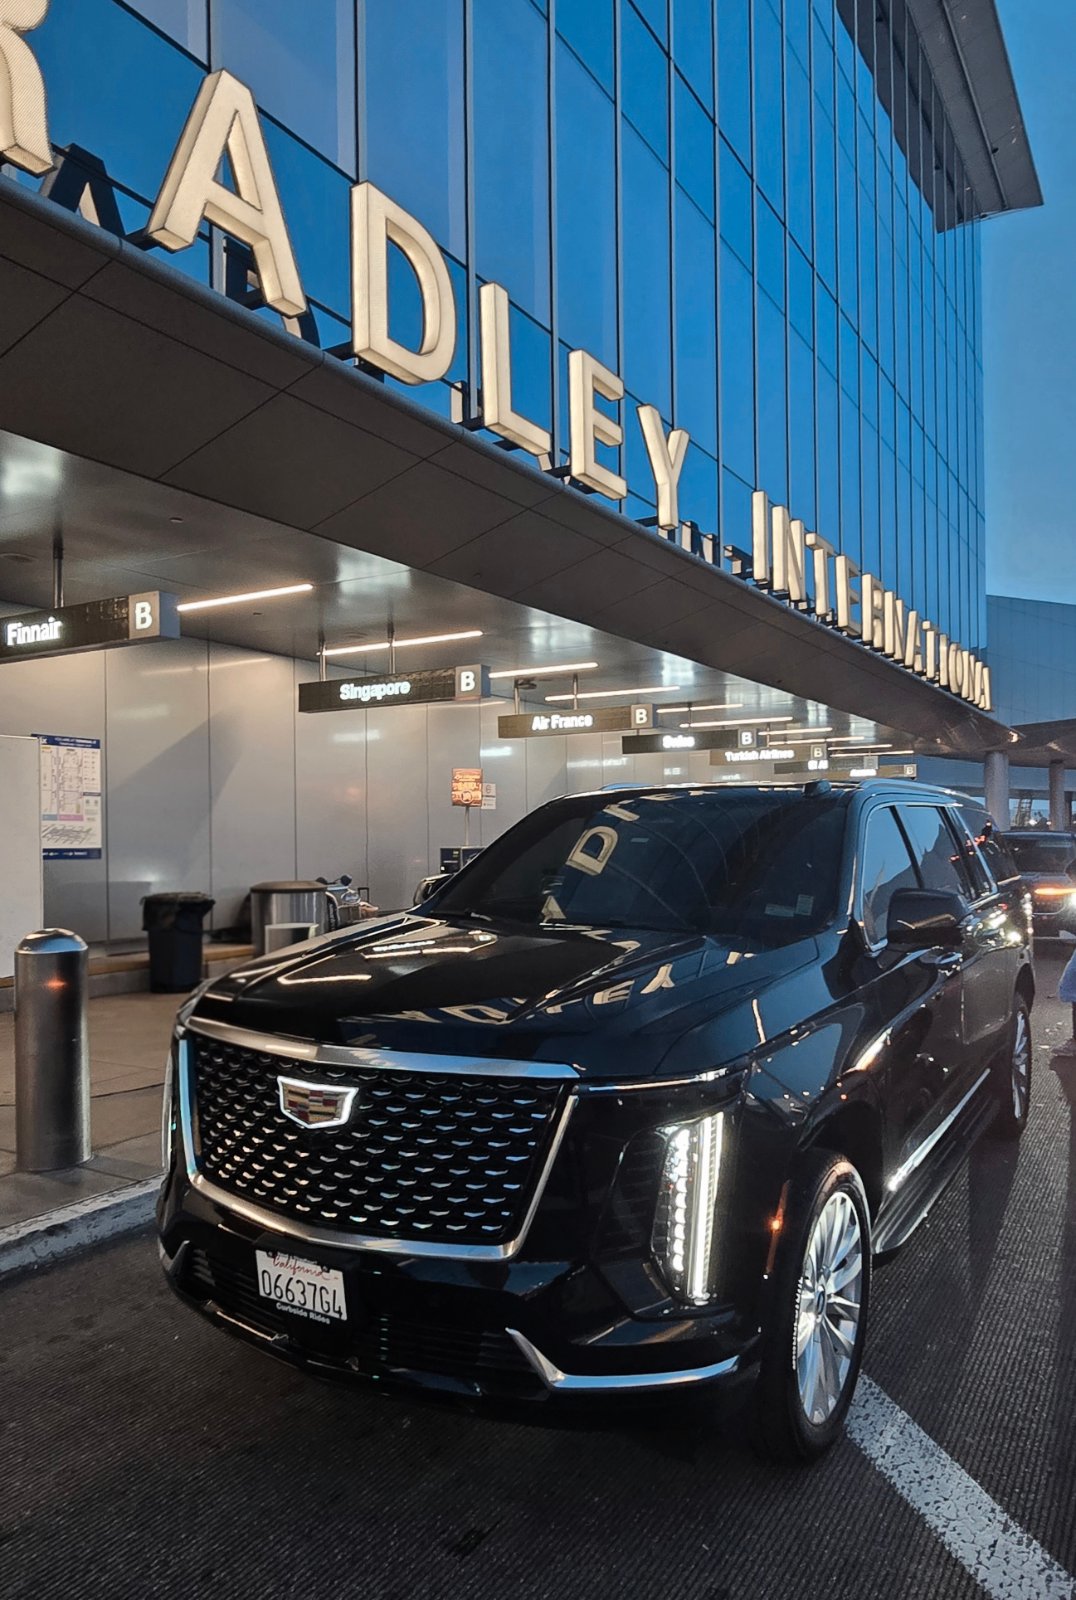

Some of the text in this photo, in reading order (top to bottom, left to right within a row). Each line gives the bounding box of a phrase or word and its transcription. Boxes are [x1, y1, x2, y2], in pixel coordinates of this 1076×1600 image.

[752, 490, 993, 711] INTERNATIONA
[6, 601, 153, 646] Finnair B
[339, 671, 475, 702] Singapore B
[532, 708, 648, 731] Air France B
[741, 731, 752, 745] B
[813, 746, 823, 758] B
[905, 766, 914, 775] B
[261, 1269, 343, 1318] 06637G4
